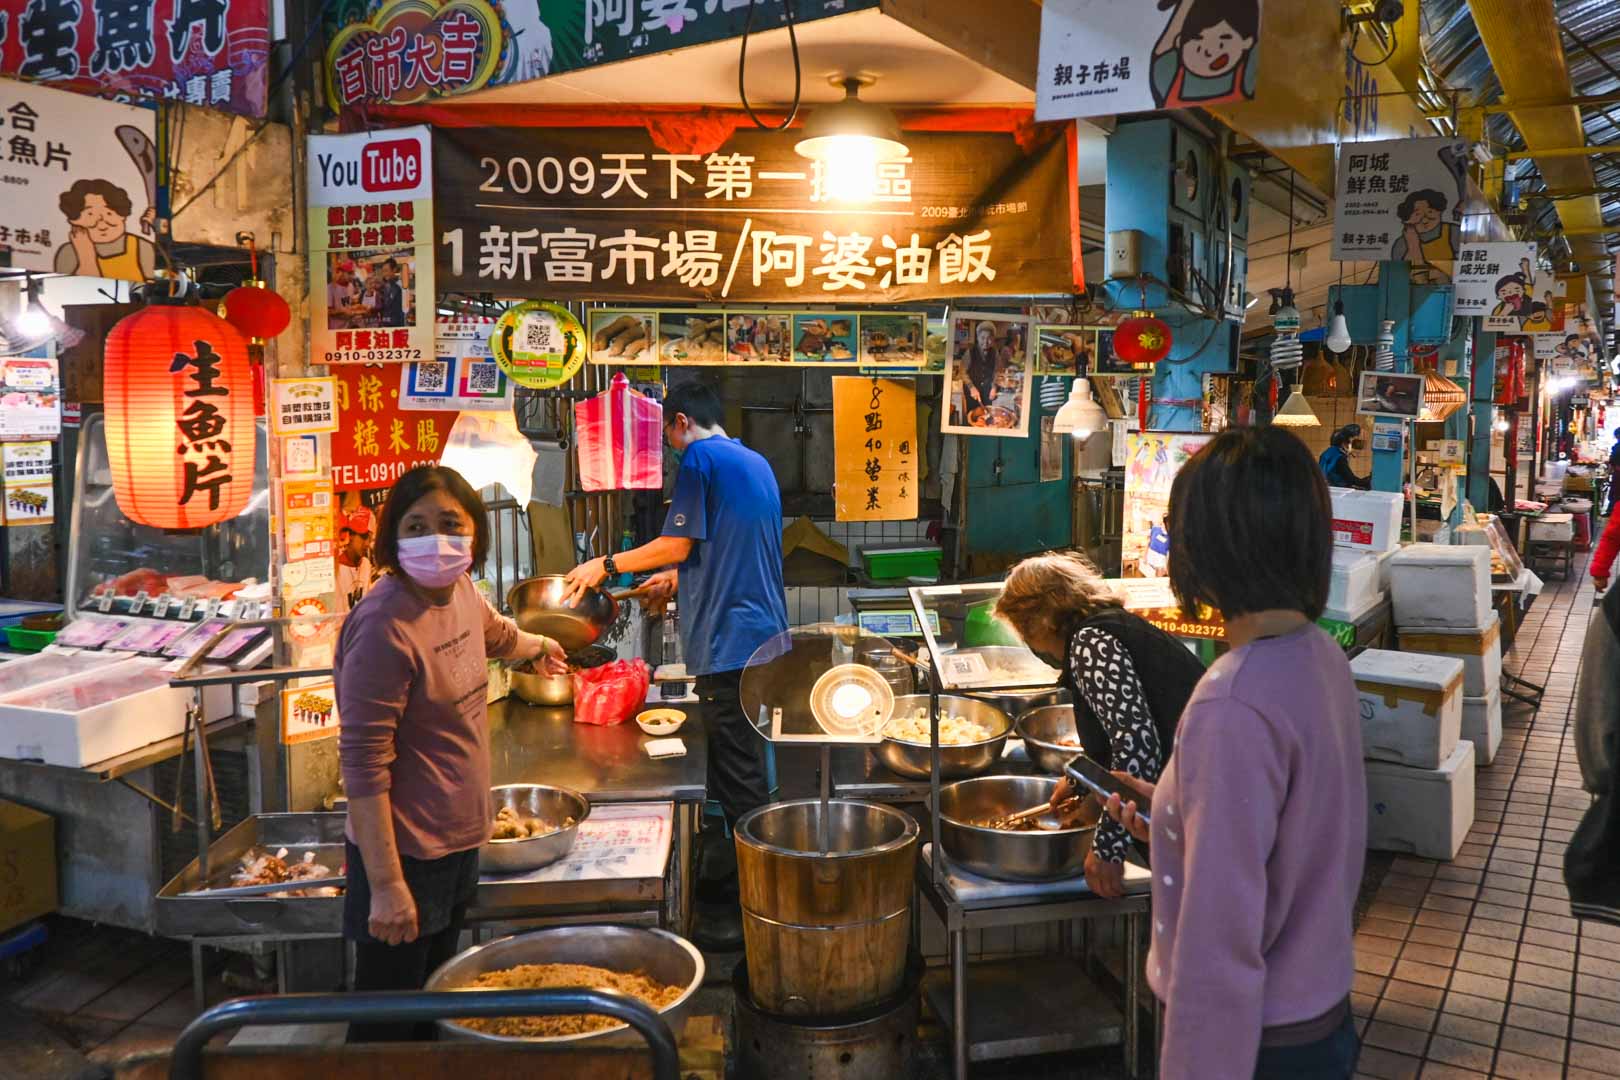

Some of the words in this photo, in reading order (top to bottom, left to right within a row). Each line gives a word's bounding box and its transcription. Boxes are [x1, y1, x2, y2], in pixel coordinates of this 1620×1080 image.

[0, 0, 229, 81] 生魚片
[1054, 57, 1131, 87] 親子市場
[1094, 86, 1119, 97] market
[0, 101, 39, 133] 合
[0, 134, 72, 172] 魚片
[1349, 152, 1390, 173] 阿城
[479, 148, 913, 202] 2009天下第一區
[1346, 174, 1410, 195] 鮮魚號
[1460, 249, 1488, 262] 唐記
[324, 349, 422, 362] 0910-032372
[335, 328, 411, 353] 阿婆油飯
[168, 339, 234, 512] 生魚片
[353, 417, 440, 457] 糯米腸
